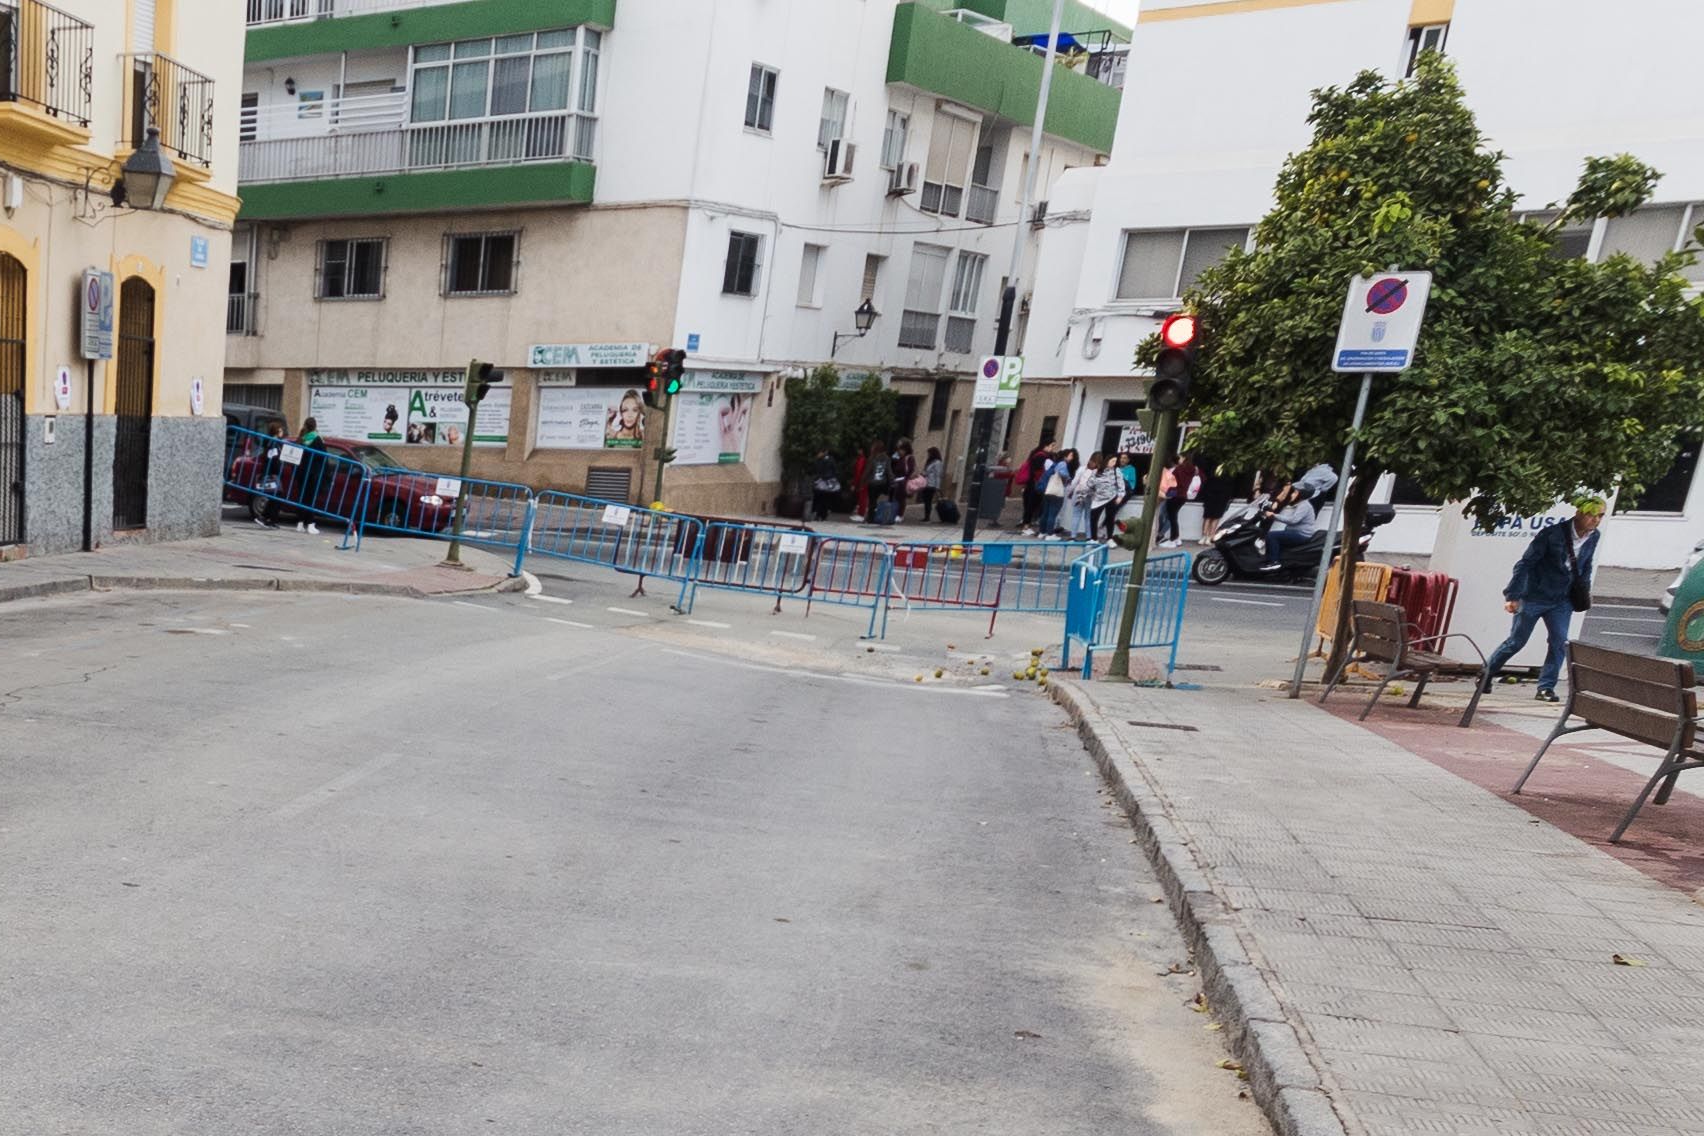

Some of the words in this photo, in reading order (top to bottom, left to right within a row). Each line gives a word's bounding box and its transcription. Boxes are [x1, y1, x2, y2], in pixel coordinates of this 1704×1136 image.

[357, 371, 428, 383] PELUQUERIA
[432, 371, 440, 383] Y
[347, 389, 368, 398] CEM
